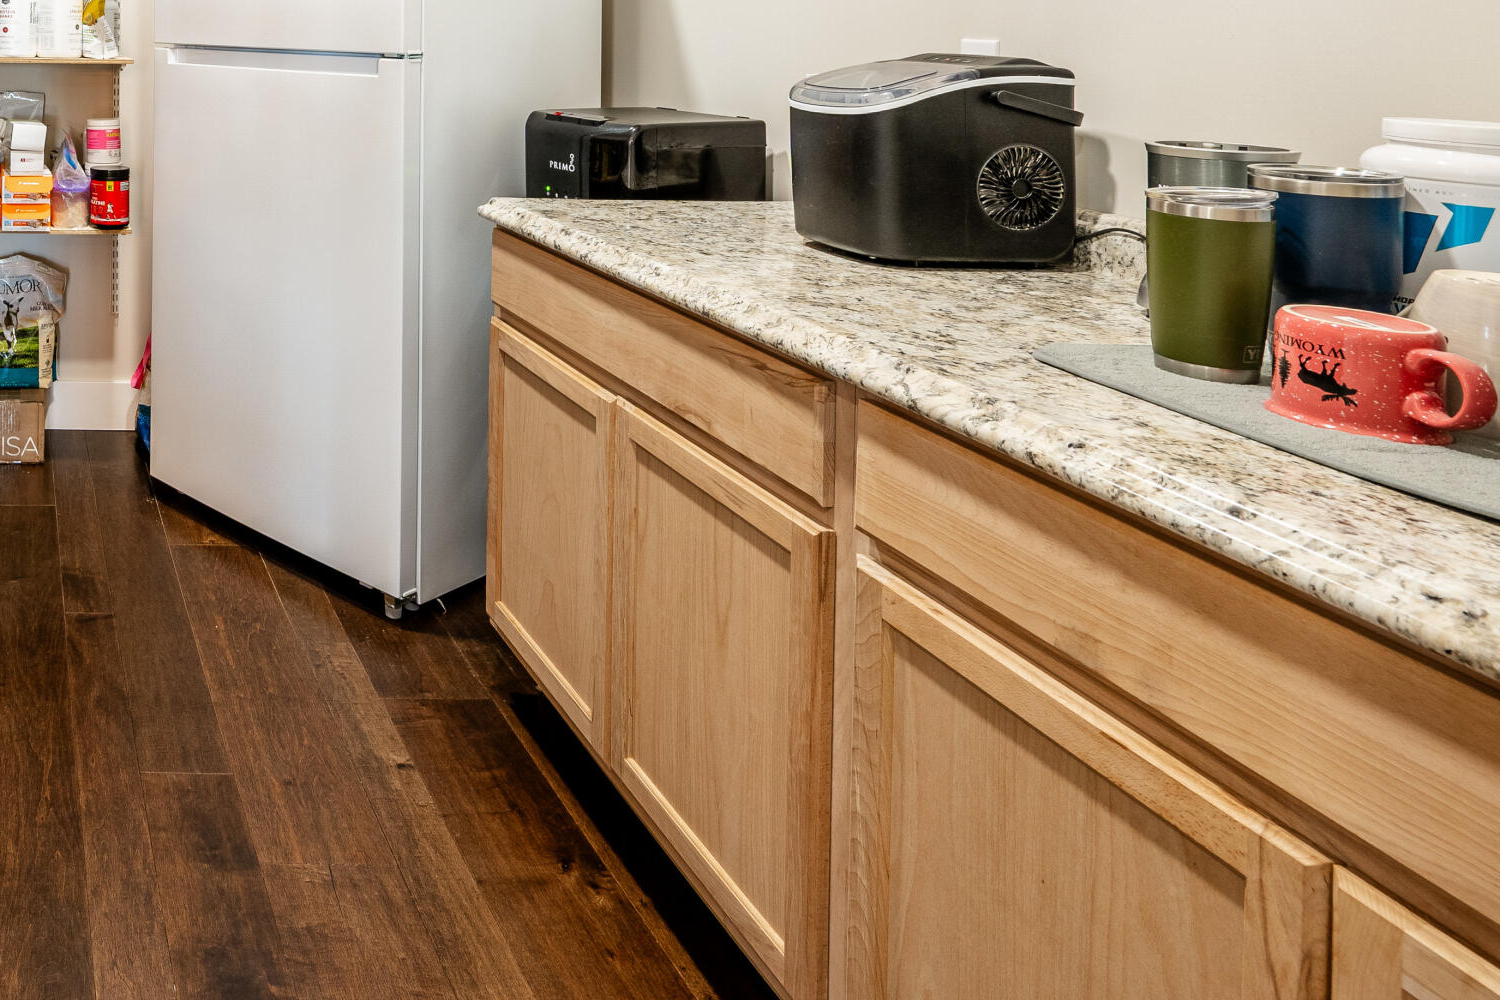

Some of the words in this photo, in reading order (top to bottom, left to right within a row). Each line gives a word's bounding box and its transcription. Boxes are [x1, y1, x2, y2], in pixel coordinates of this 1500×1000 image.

[549, 157, 575, 172] PRIMO
[1275, 330, 1347, 360] WYOMING
[1, 436, 39, 457] ISA
